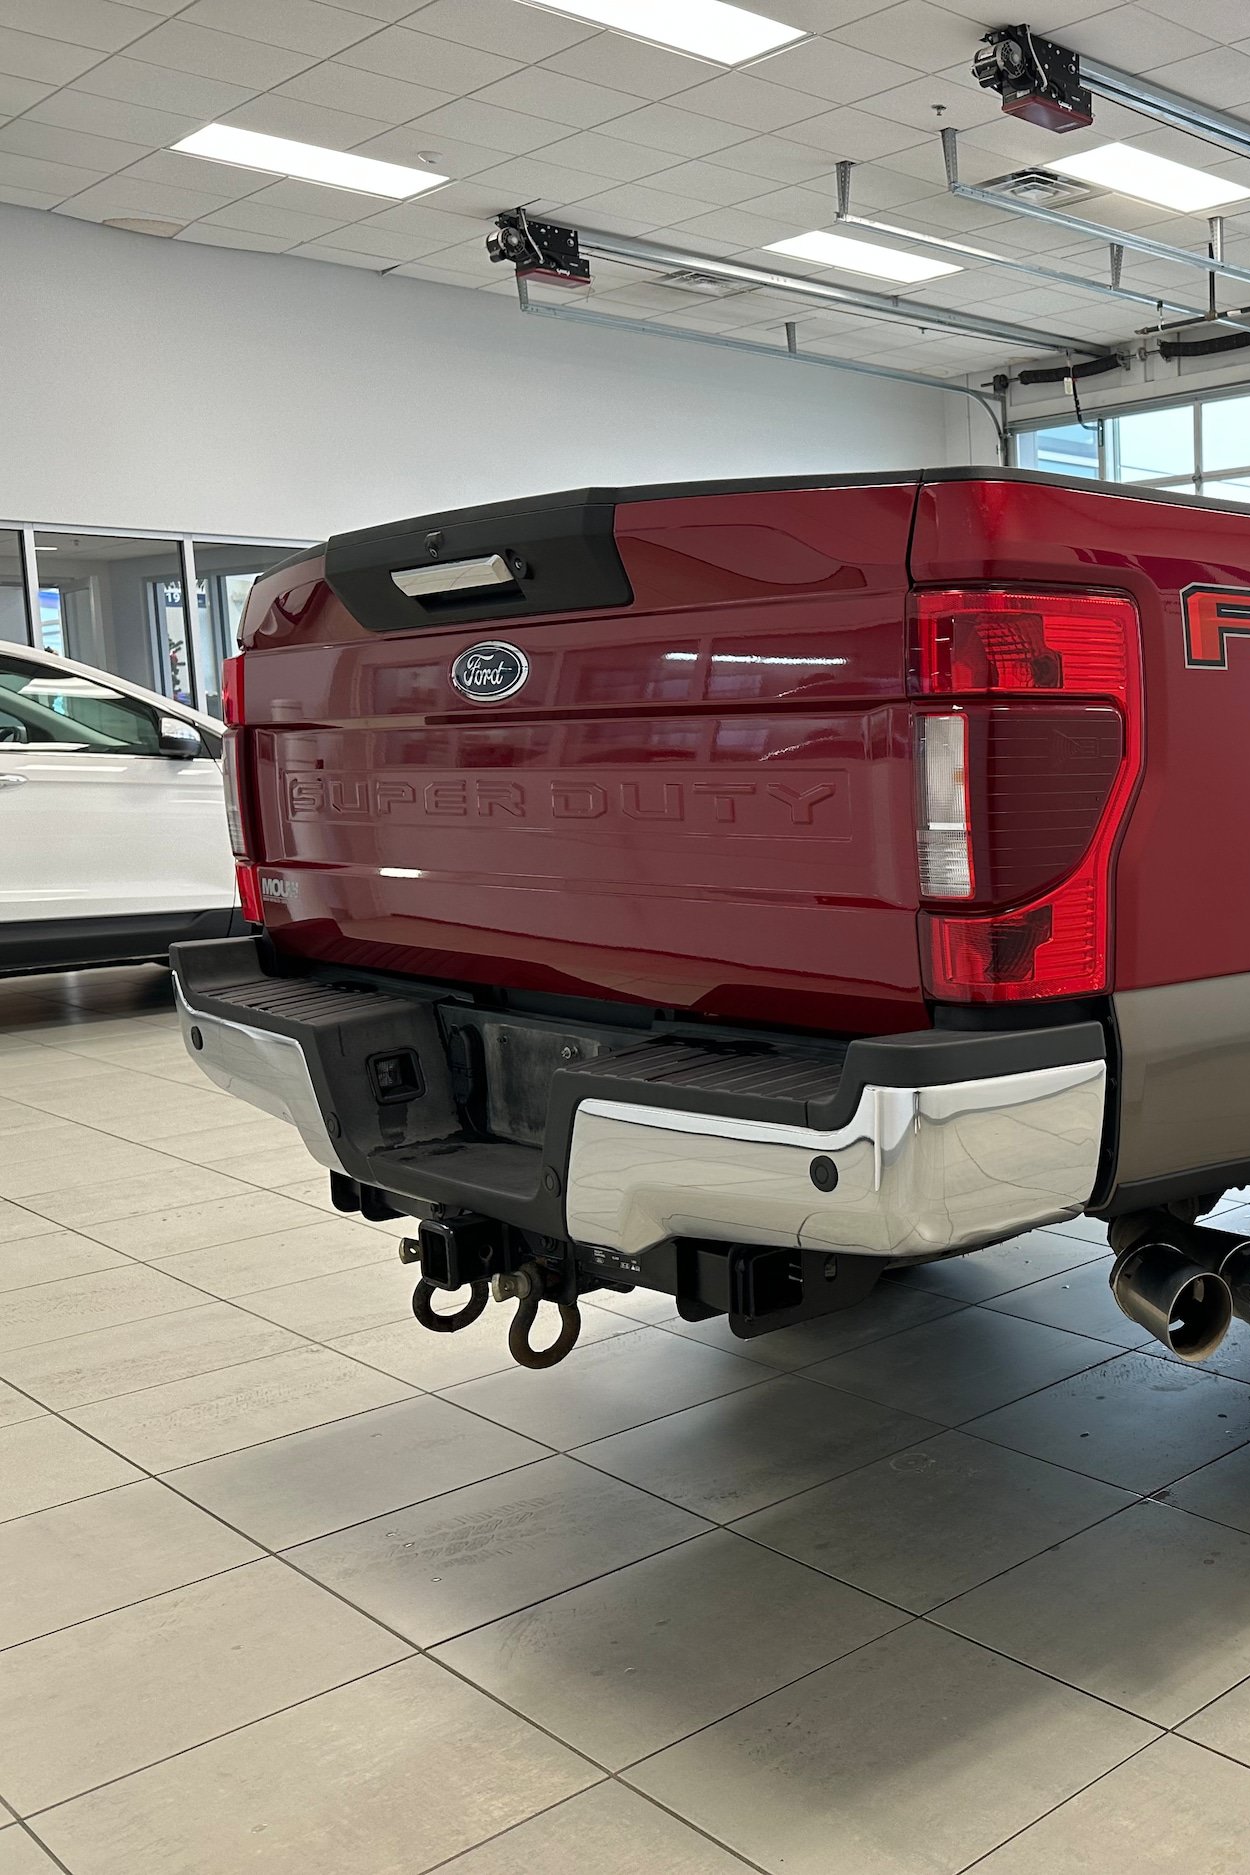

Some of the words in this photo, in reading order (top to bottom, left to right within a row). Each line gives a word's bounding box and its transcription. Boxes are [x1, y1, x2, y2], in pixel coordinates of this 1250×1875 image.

[463, 654, 513, 687] Ford
[290, 777, 525, 818] SUPER
[551, 780, 838, 826] DUTY
